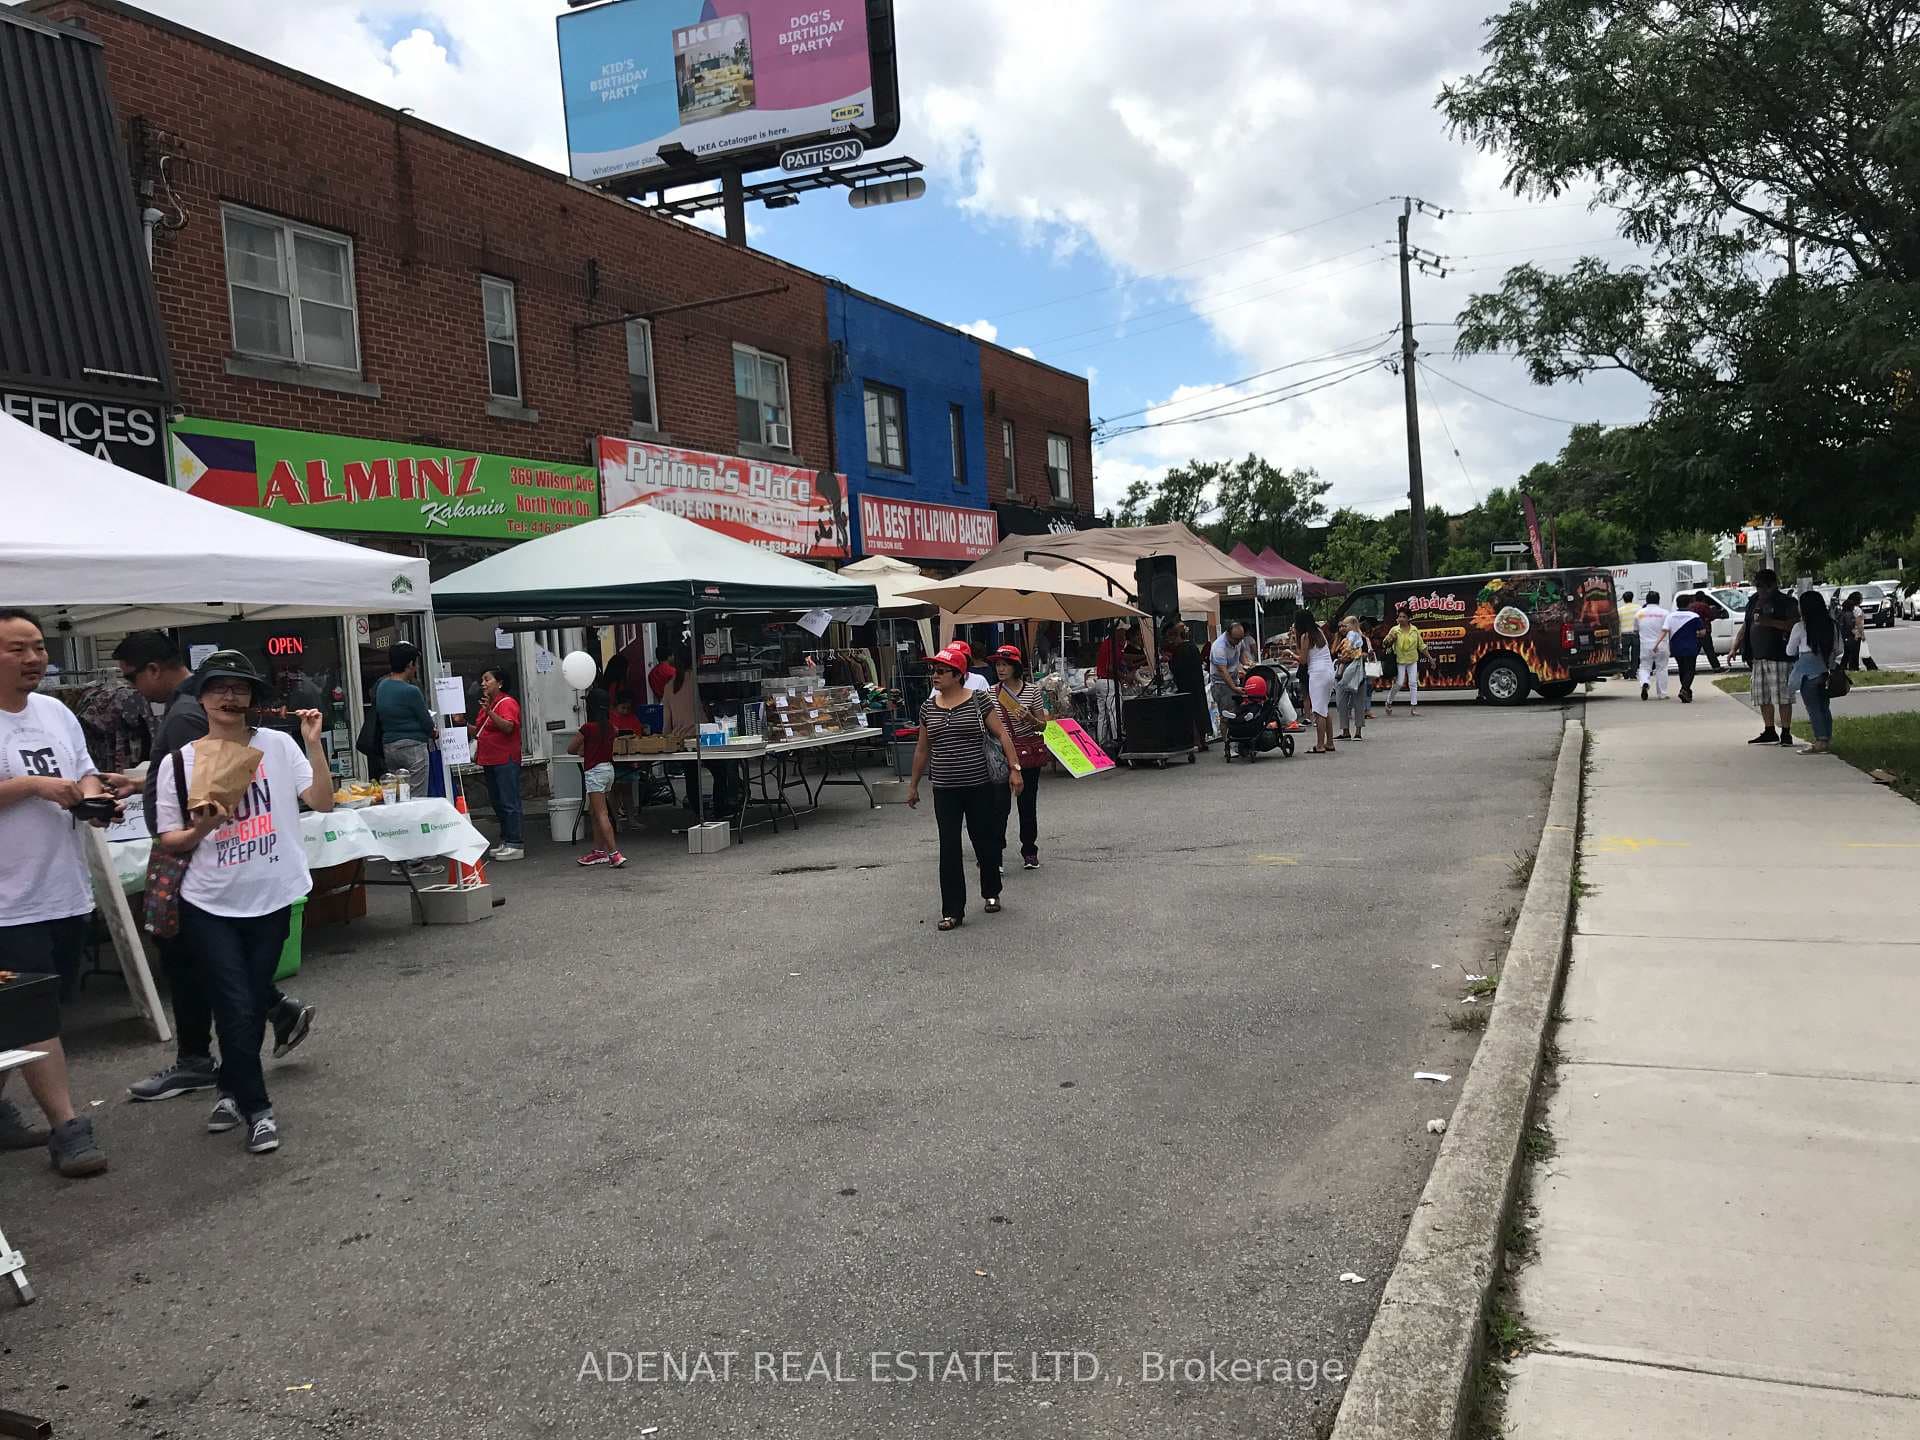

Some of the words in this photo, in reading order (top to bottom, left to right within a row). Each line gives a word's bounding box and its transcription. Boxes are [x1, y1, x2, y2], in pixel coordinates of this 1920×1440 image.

[778, 19, 845, 45] BIRTHDAY
[790, 9, 831, 29] DOG'S
[678, 18, 746, 48] IKEA
[791, 36, 833, 56] PARTY
[589, 68, 649, 93] BIRTHDAY
[601, 58, 635, 77] KID'S
[601, 83, 639, 103] PARTY
[834, 107, 861, 119] IKEA
[697, 143, 717, 154] IKEA
[718, 132, 757, 151] Catalogue
[759, 129, 767, 139] is
[768, 126, 790, 138] here.
[592, 161, 624, 176] Whatever
[786, 143, 858, 169] PATTISON
[0, 394, 156, 447] FFICES
[264, 456, 486, 510] ALMINZ
[510, 467, 533, 487] 369
[536, 469, 574, 491] Wilson
[575, 475, 596, 493] Ave
[625, 445, 740, 494] Prima's
[748, 464, 810, 500] Place
[421, 498, 507, 529] Kakanin
[515, 494, 548, 514] North
[550, 496, 574, 516] York
[720, 503, 752, 523] HAIR
[757, 509, 799, 527] SALON
[507, 519, 528, 533] Tel:
[863, 501, 882, 537] DA
[882, 503, 912, 541] BEST
[913, 507, 957, 544] FILIPINO
[959, 512, 994, 546] BAKERY
[268, 636, 304, 656] OPEN
[234, 778, 272, 822] UN
[239, 813, 276, 842] GIRL
[215, 839, 230, 851] TRY
[216, 840, 257, 868] KEEP
[259, 832, 277, 857] UP
